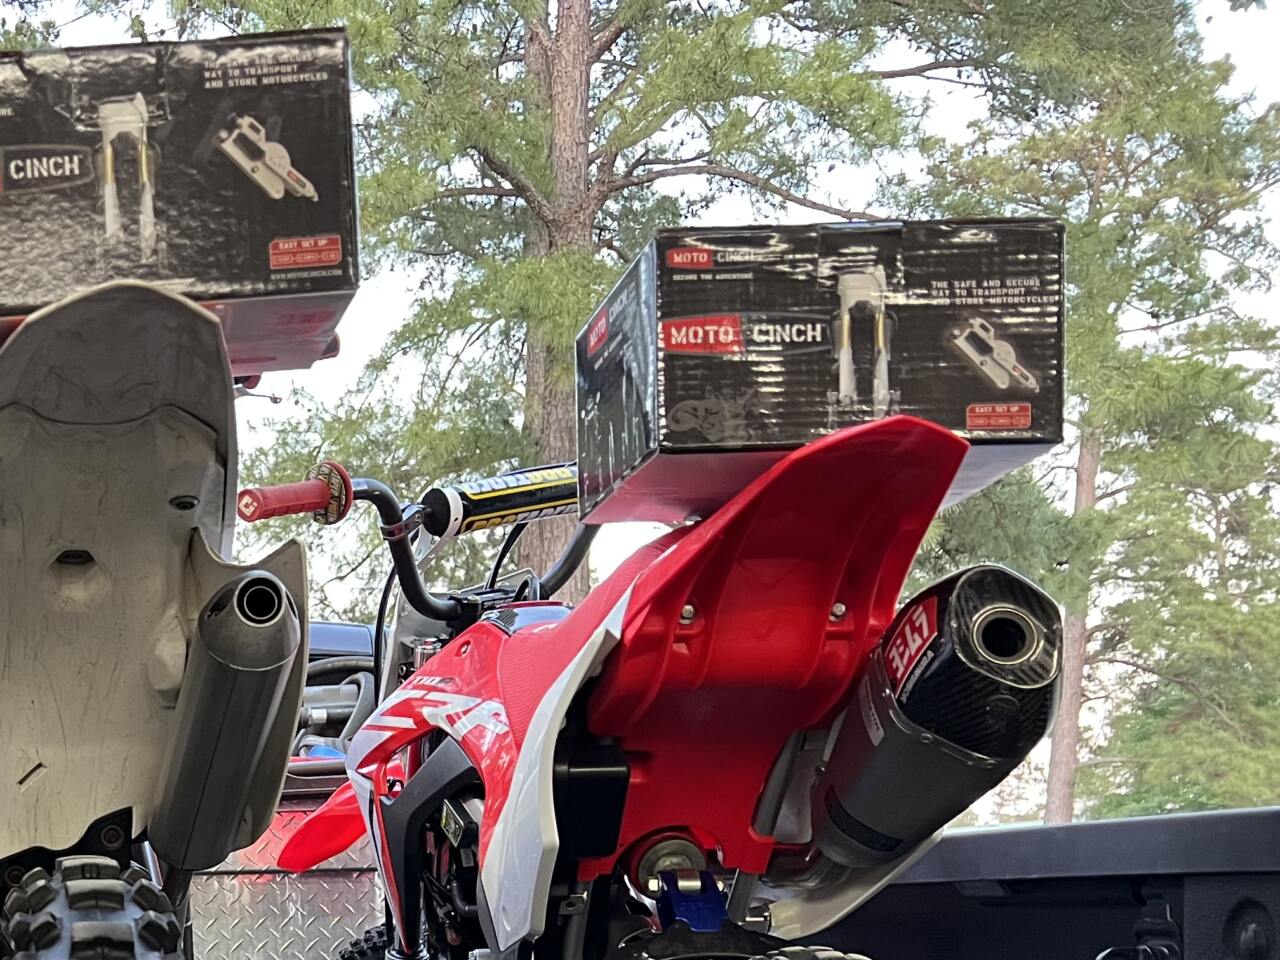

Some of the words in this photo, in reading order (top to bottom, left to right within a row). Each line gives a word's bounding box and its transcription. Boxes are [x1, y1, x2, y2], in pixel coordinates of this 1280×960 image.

[204, 70, 222, 78] WAY
[228, 68, 240, 77] TO
[245, 64, 298, 76] TRANSPORT
[205, 80, 223, 89] AND
[228, 78, 257, 87] STORE
[262, 72, 328, 85] MOTORCYCLES
[9, 155, 80, 180] CINCH
[673, 252, 708, 263] MOTO
[716, 250, 755, 262] CINCH
[932, 281, 949, 289] THE
[954, 280, 977, 288] SAFE
[983, 279, 1001, 287] AND
[1006, 278, 1041, 287] SECURE
[955, 289, 967, 297] TO
[973, 287, 1026, 296] TRANSPORT
[671, 325, 734, 345] MOTO
[752, 323, 822, 344] CINCH
[414, 675, 443, 685] 110
